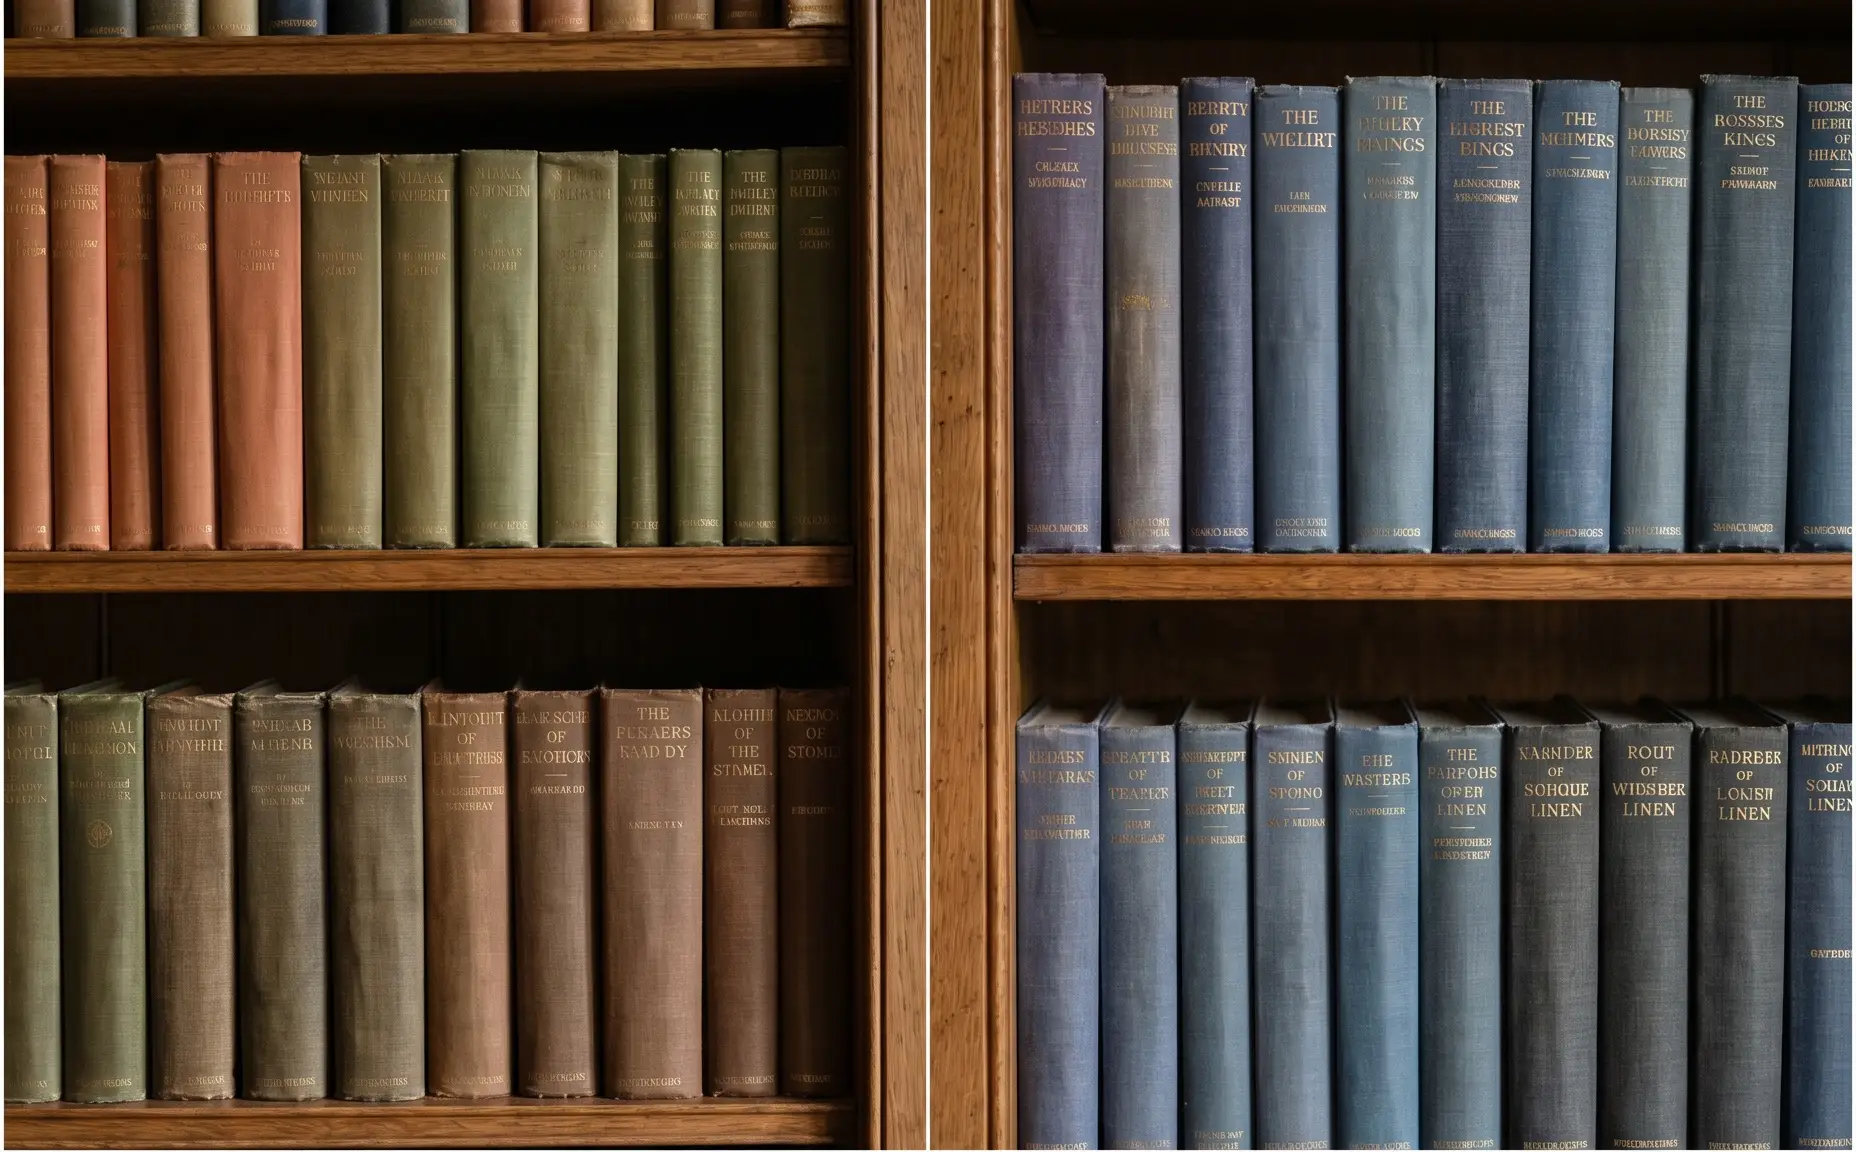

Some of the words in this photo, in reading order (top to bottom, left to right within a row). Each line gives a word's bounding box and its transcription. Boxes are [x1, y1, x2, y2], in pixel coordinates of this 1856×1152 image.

[1372, 96, 1408, 111] THE
[1470, 101, 1506, 115] THE
[1733, 95, 1767, 109] THE
[1281, 109, 1319, 125] THE
[1562, 112, 1597, 126] THE
[1644, 110, 1674, 123] THE
[1714, 114, 1785, 129] ROSSSES
[1209, 123, 1229, 135] OF
[1834, 134, 1851, 145] OF
[742, 171, 767, 183] THE
[637, 706, 670, 720] THE
[457, 732, 477, 745] OF
[547, 731, 566, 743] OF
[734, 727, 755, 739] OF
[806, 727, 826, 740] OF
[728, 745, 759, 758] THE
[1447, 748, 1478, 761] THE
[1627, 745, 1675, 760] ROUT
[1129, 769, 1147, 780] OF
[1207, 769, 1224, 779] OF
[1547, 767, 1565, 777] OF
[1640, 766, 1658, 777] OF
[1825, 763, 1843, 773] OF
[1287, 770, 1305, 781] OF
[1612, 782, 1687, 796] WIDSBER
[1531, 803, 1583, 817] LINEN
[1623, 802, 1676, 816] LINEN
[1719, 806, 1771, 820] LINEN
